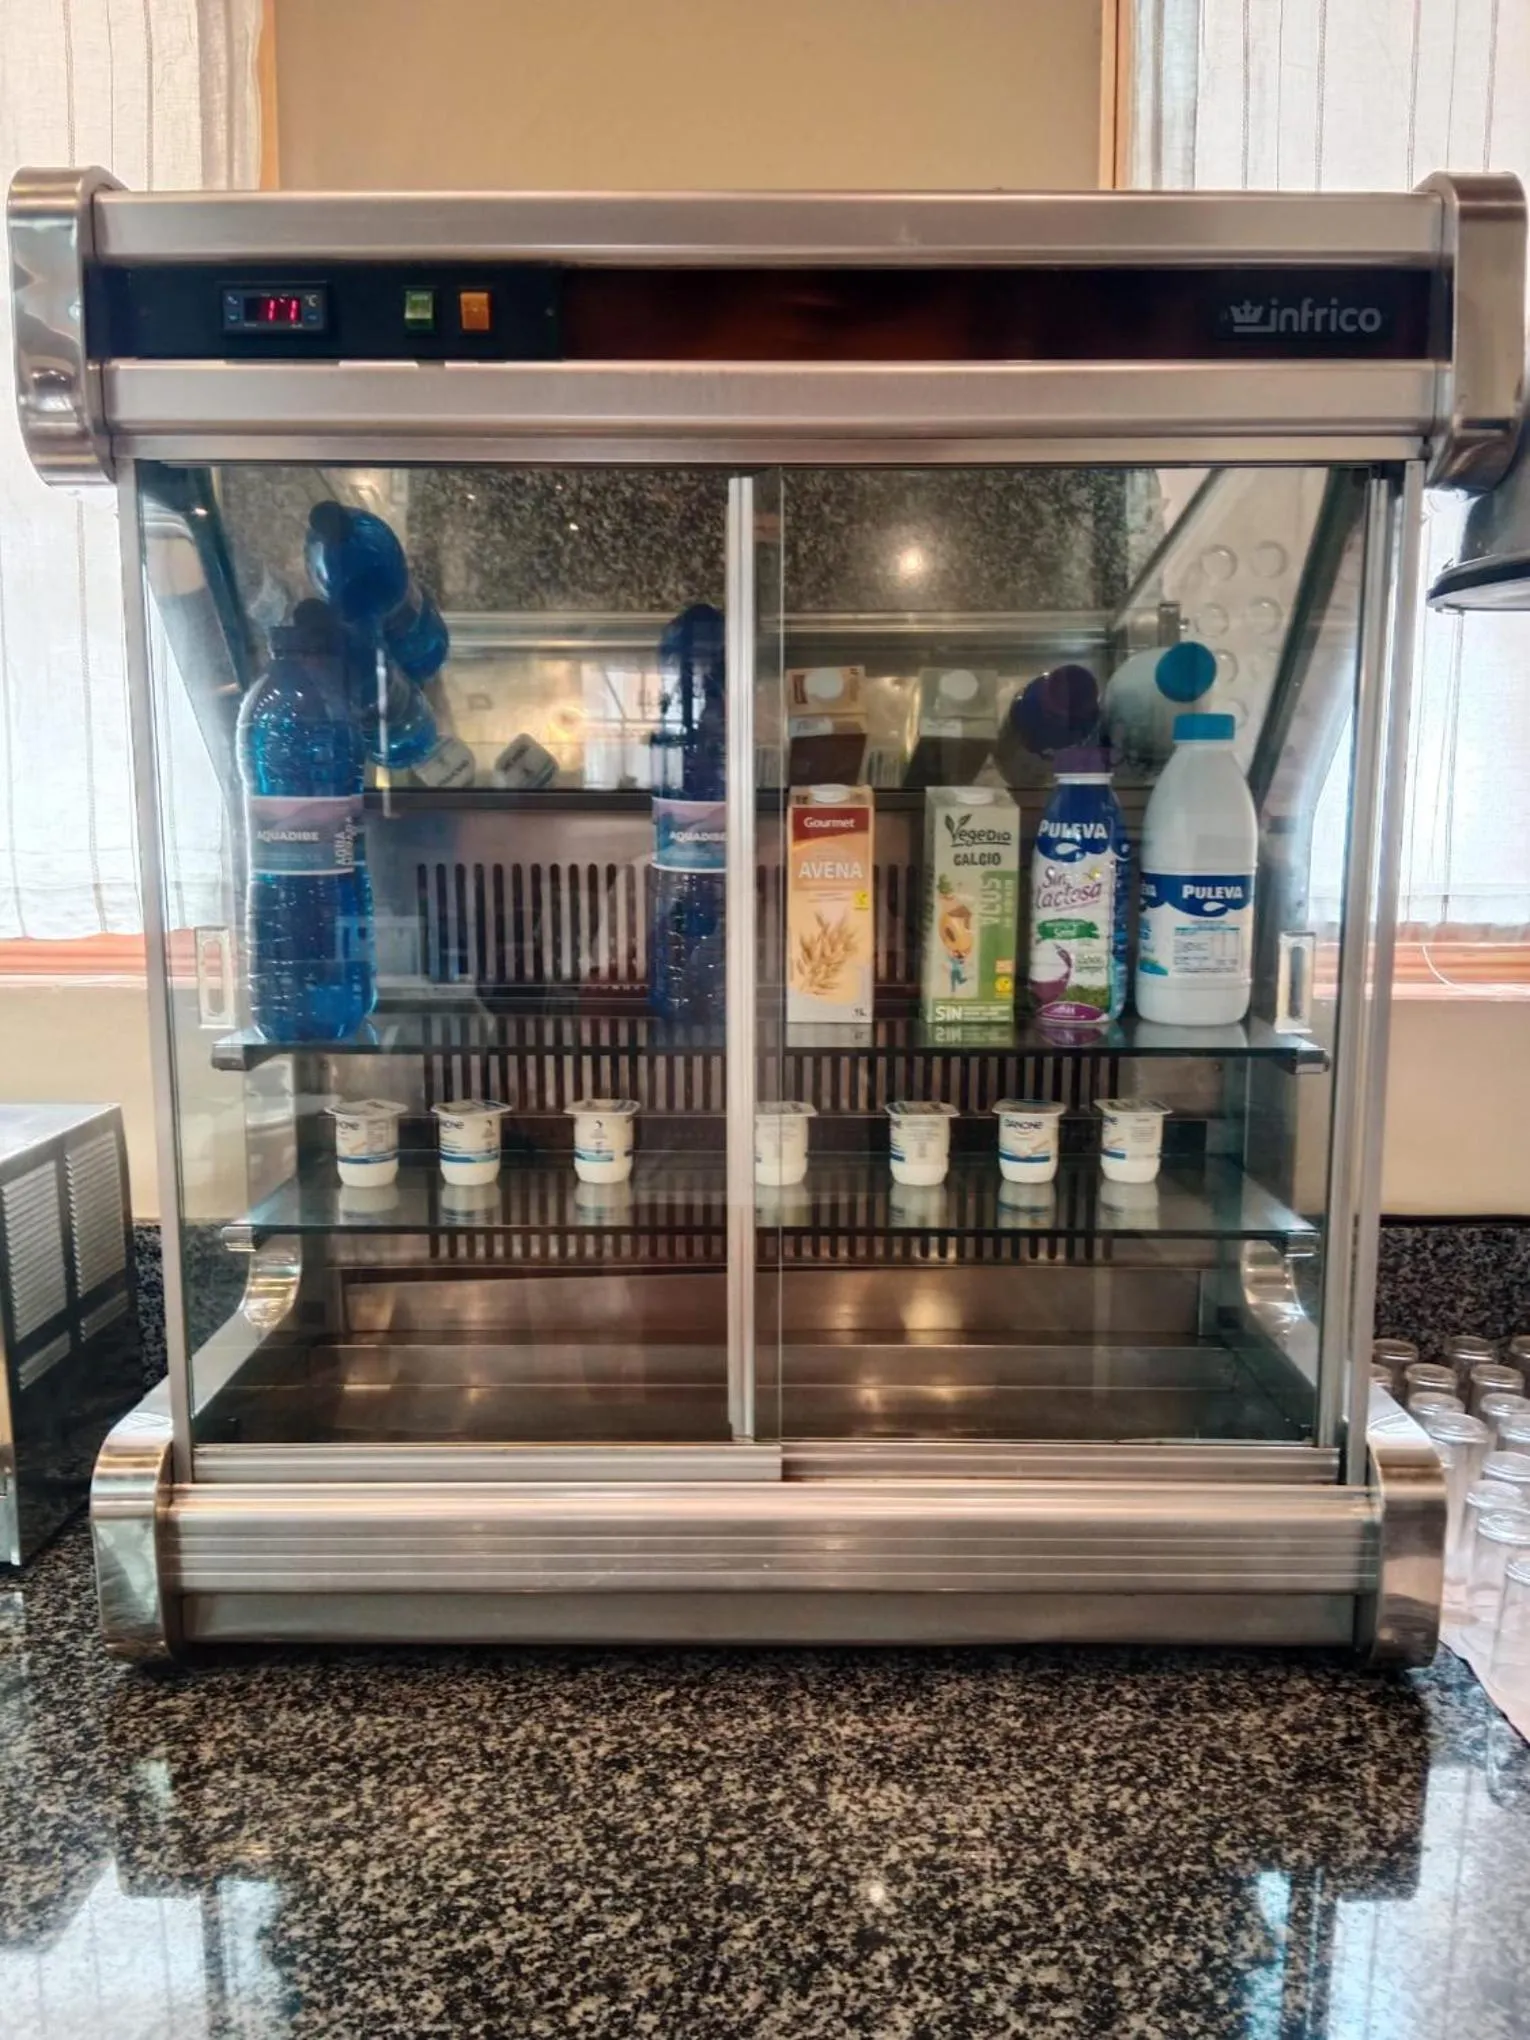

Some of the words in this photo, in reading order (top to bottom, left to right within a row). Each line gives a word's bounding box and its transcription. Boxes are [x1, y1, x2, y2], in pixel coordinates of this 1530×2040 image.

[1270, 297, 1383, 332] infrico
[803, 816, 855, 829] Gourmet
[1038, 819, 1108, 840] PULEVA
[953, 851, 1002, 867] CALCIO
[798, 861, 864, 880] AVENA
[1181, 883, 1244, 899] PULEVA
[935, 1005, 962, 1021] SIN
[1004, 1118, 1044, 1130] DANONE
